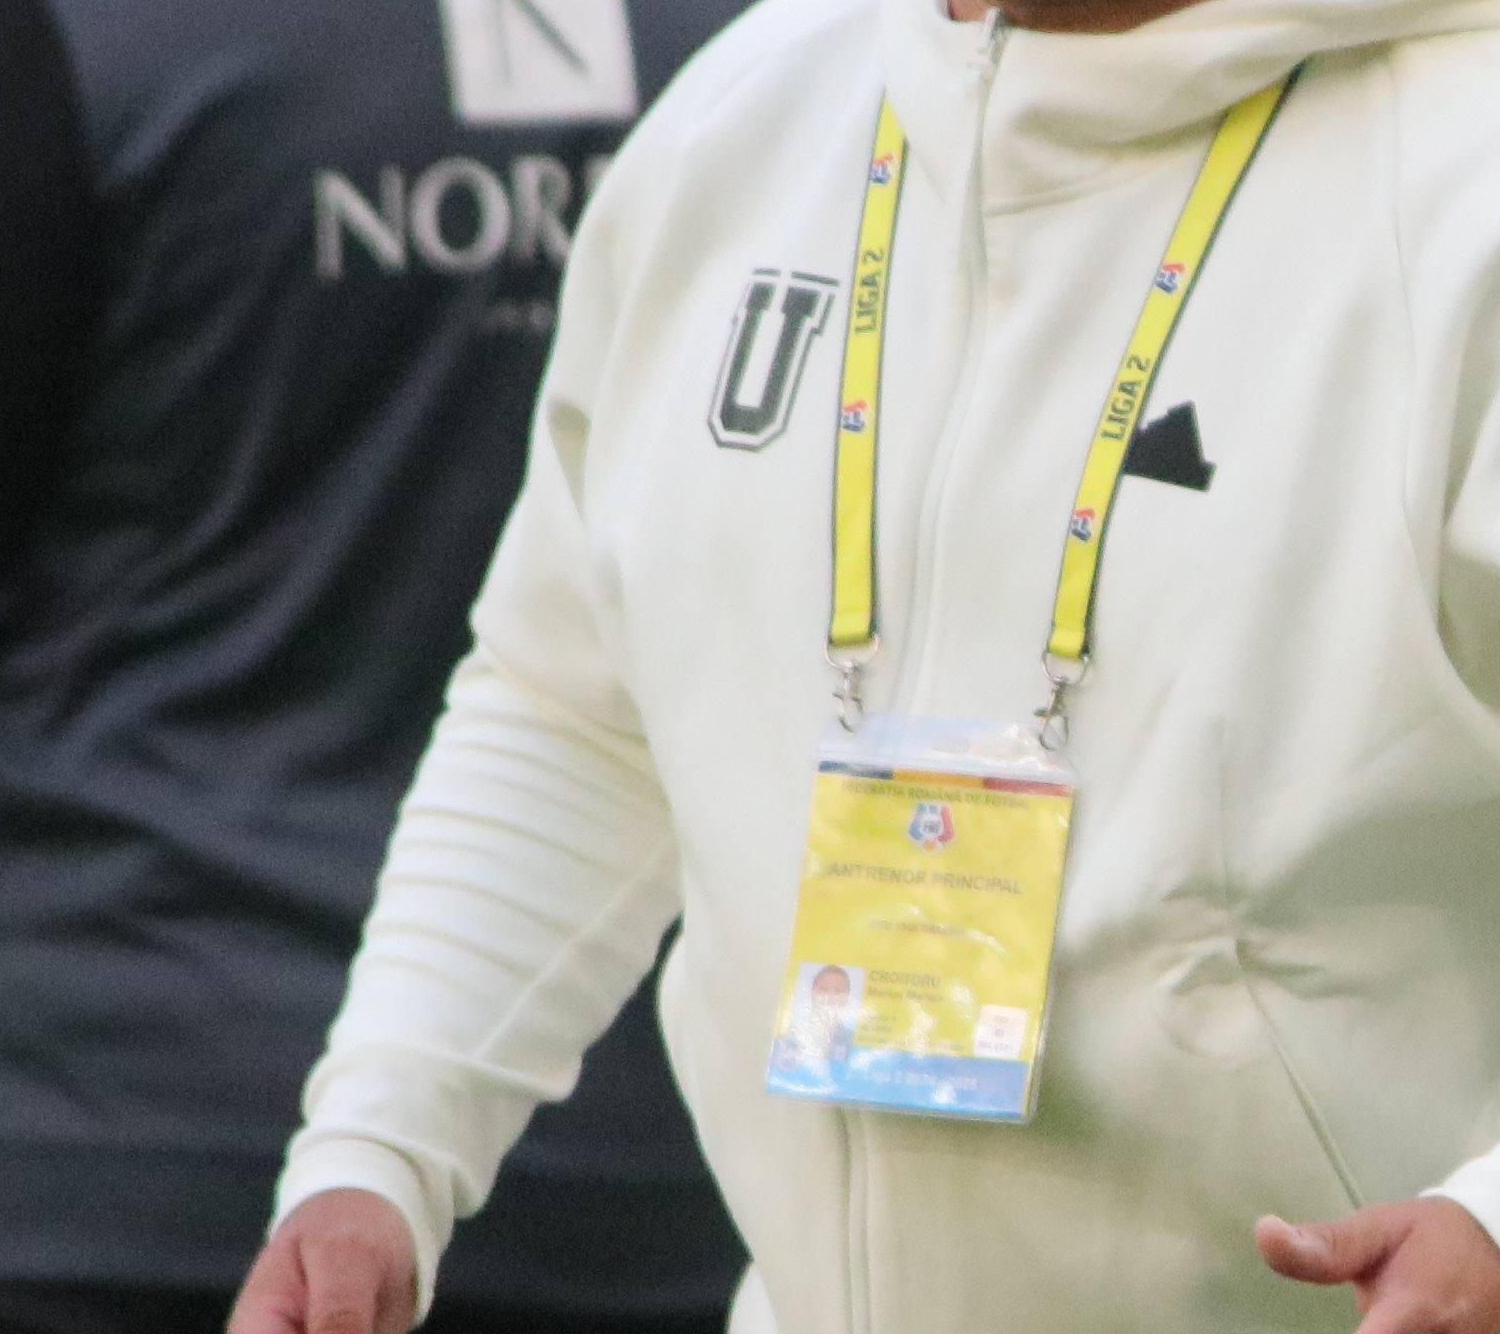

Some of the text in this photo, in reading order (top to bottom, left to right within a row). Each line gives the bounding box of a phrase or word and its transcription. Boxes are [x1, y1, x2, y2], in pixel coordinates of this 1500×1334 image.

[314, 155, 612, 280] NOR
[855, 246, 885, 334] LIGA 2
[1100, 354, 1151, 442] LIGA 2
[828, 863, 1023, 895] ANTRENOR PRINCIPAL
